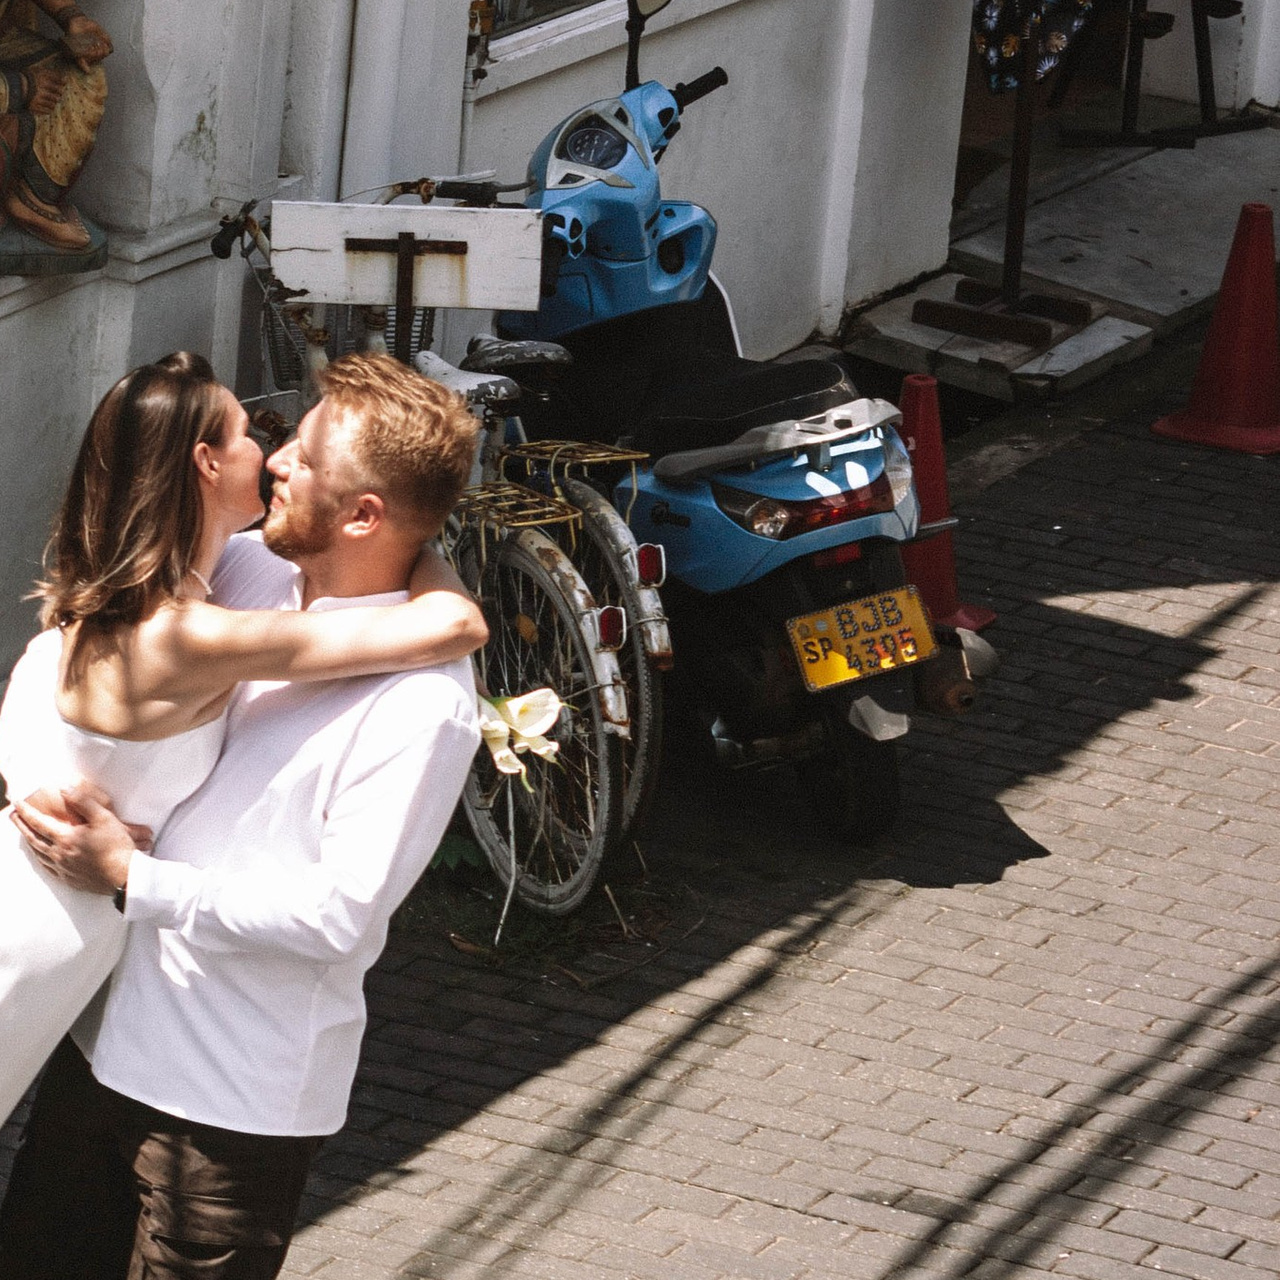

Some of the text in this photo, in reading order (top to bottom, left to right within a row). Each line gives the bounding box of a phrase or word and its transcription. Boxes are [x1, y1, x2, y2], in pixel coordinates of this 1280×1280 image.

[835, 596, 902, 639] BJB
[802, 626, 918, 671] SP 4395
